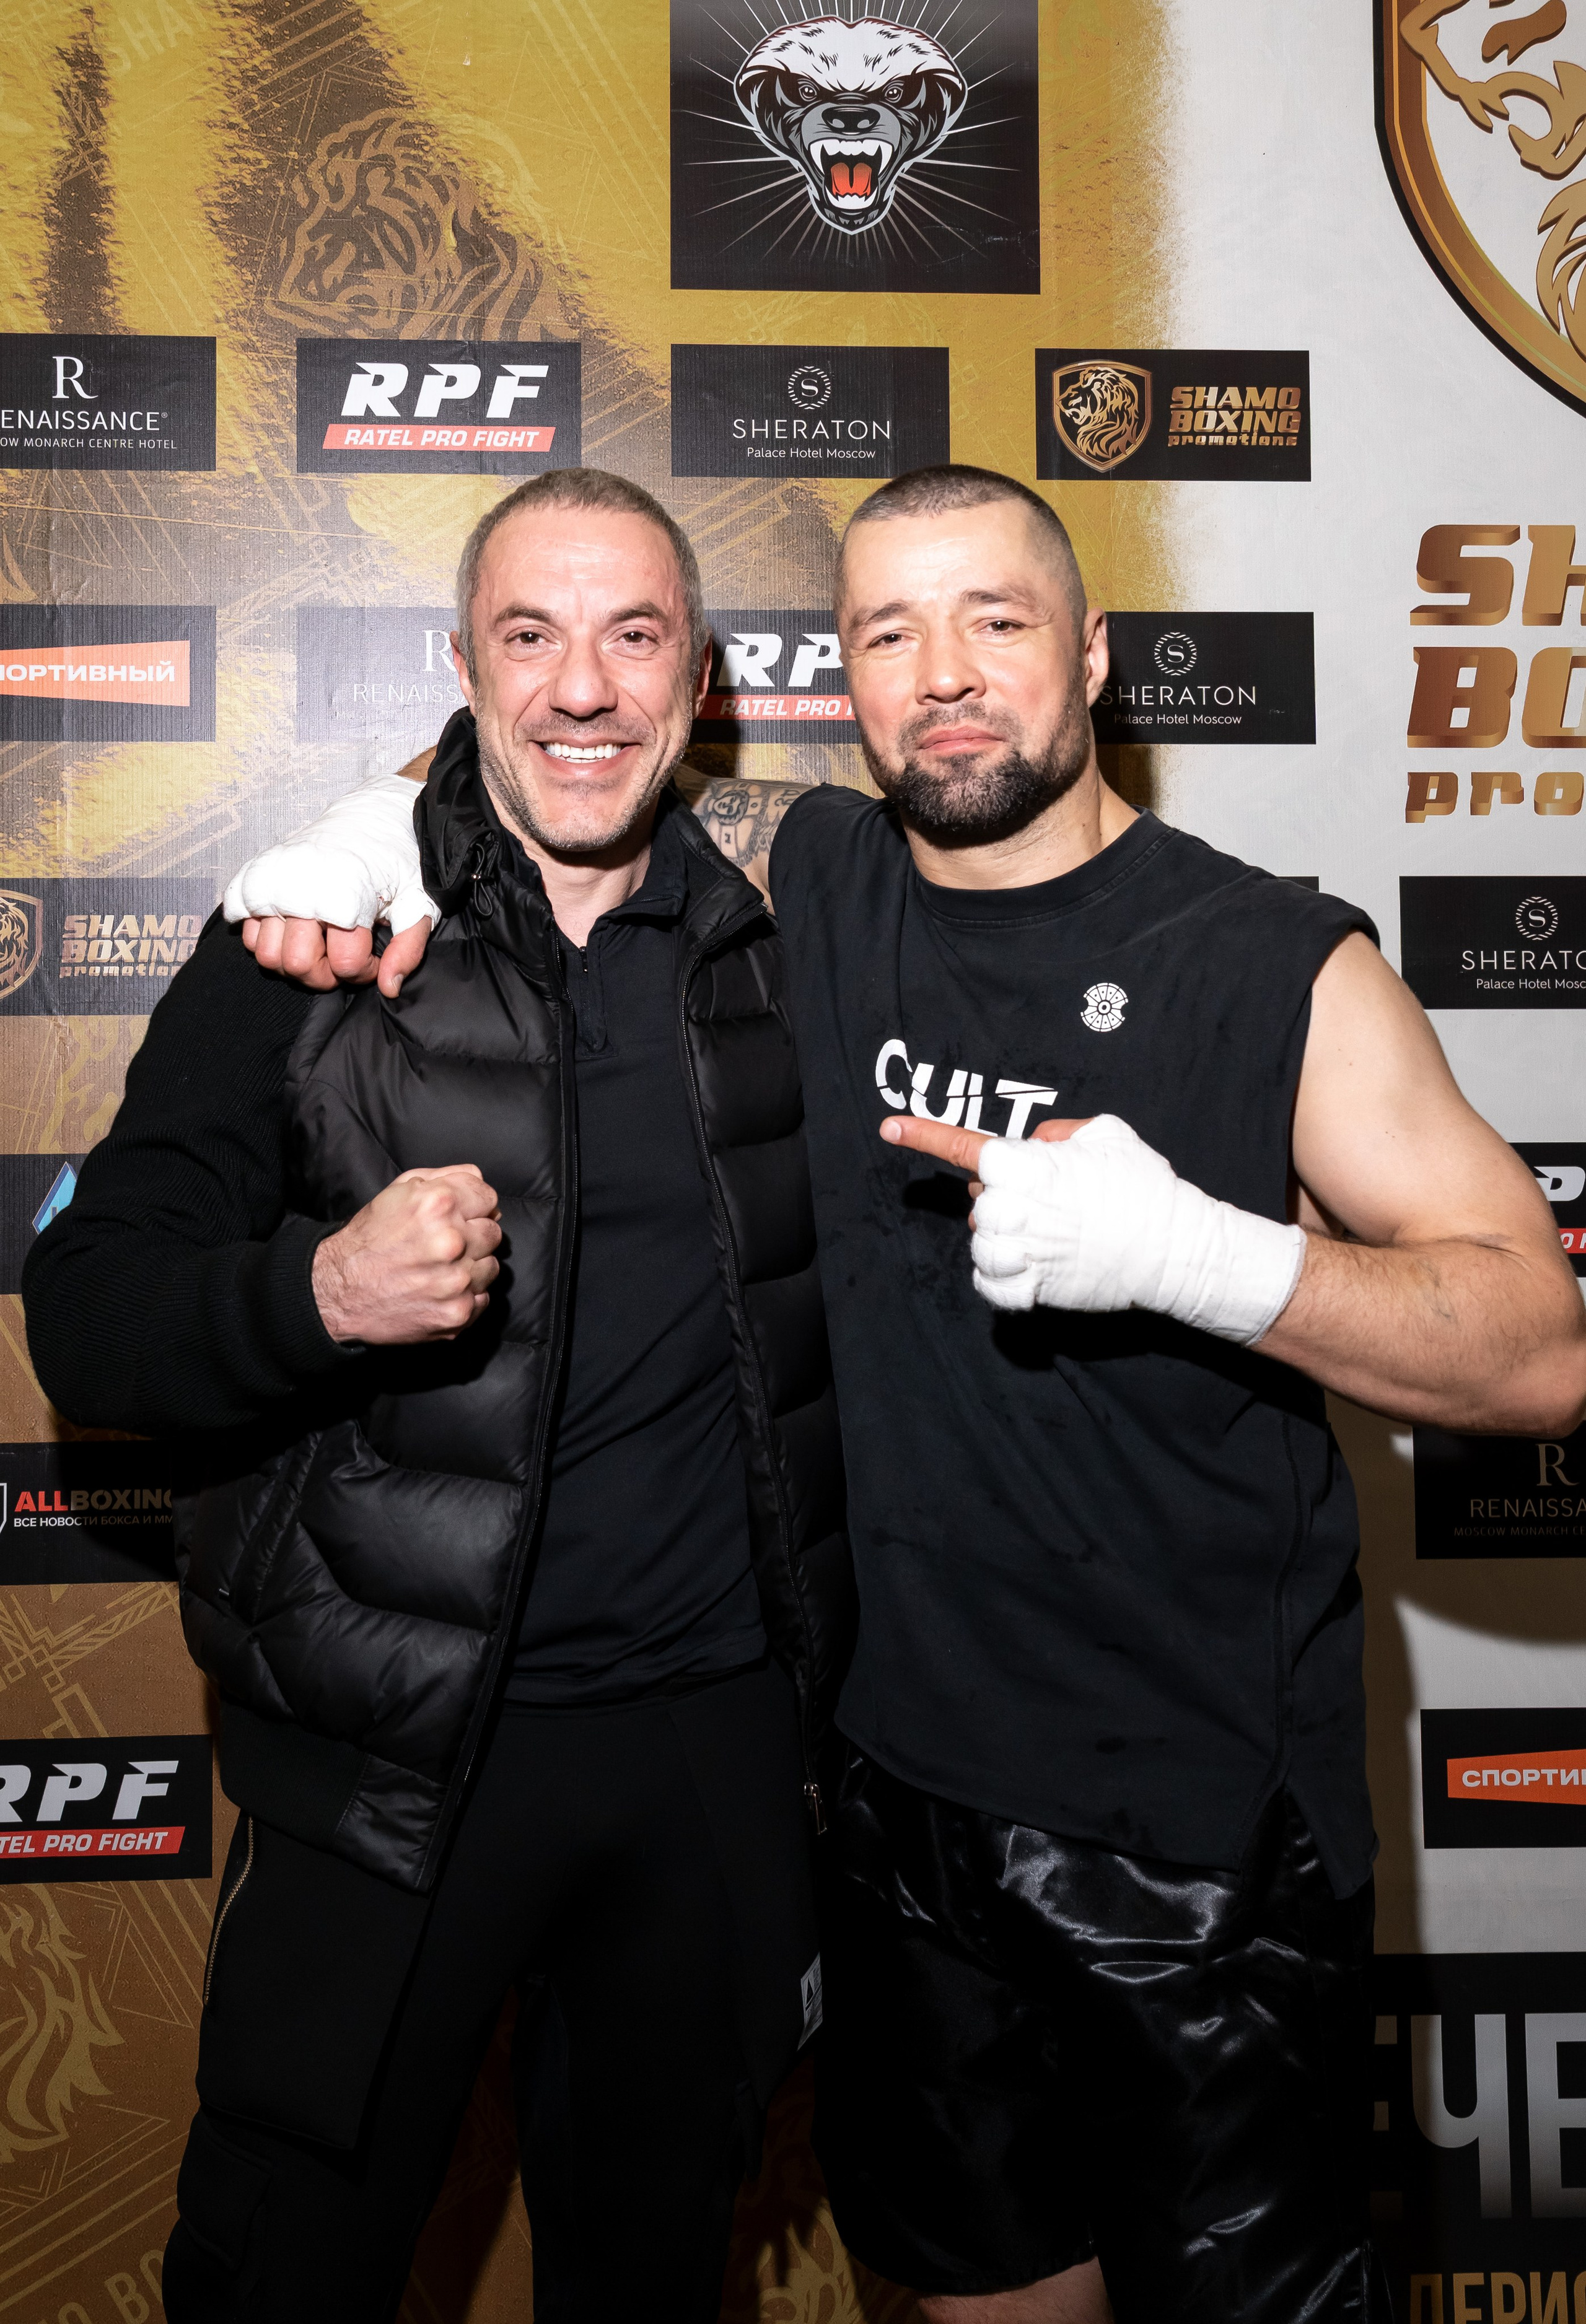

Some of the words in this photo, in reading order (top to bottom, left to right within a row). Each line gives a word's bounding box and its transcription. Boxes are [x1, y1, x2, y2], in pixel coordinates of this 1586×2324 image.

[53, 356, 99, 399] R
[341, 362, 549, 418] RPF
[1170, 387, 1301, 409] SHAMO
[733, 419, 890, 440] SHERATON
[1169, 410, 1301, 433] BOXING
[0, 437, 19, 447] OW
[24, 438, 84, 448] MONARCH
[89, 439, 134, 448] CENTRE
[139, 439, 177, 449] HOTEL
[344, 429, 413, 446] RATEL
[421, 430, 467, 447] PRO
[473, 431, 540, 448] FIGHT
[1168, 432, 1297, 447] promotions
[747, 447, 786, 458] Palace
[790, 448, 822, 458] Hotel
[827, 448, 875, 458] Moscow
[422, 630, 457, 672] R
[716, 633, 843, 687] RP
[0, 660, 175, 682] ОРТИВНЫЙ
[1099, 686, 1256, 706] SHERATON
[720, 699, 787, 716] RATEL
[795, 699, 841, 716] PRO
[1115, 714, 1152, 724] Palace
[1157, 714, 1188, 724] Hotel
[1193, 714, 1242, 724] Moscow
[1405, 772, 1584, 823] pro
[63, 915, 202, 938] SHAMO
[1476, 979, 1515, 989] Palace
[1519, 979, 1551, 989] Hotel
[1556, 979, 1586, 989] Mosc
[875, 1039, 1058, 1140] CULT
[1535, 1443, 1580, 1487] R
[1470, 1498, 1586, 1518] RENAISSA
[14, 1518, 37, 1527] ВСЕ
[40, 1516, 97, 1526] НОВОСТИ
[101, 1516, 139, 1525] БОКСА
[143, 1516, 151, 1524] И
[1454, 1527, 1505, 1536] MOSCOW
[1510, 1527, 1567, 1536] MONARCH
[1462, 1769, 1586, 1788] СПОРТИ
[43, 1834, 92, 1852] PRO
[98, 1832, 169, 1851] FIGHT
[1409, 2271, 1586, 2324] ПЕРИ
